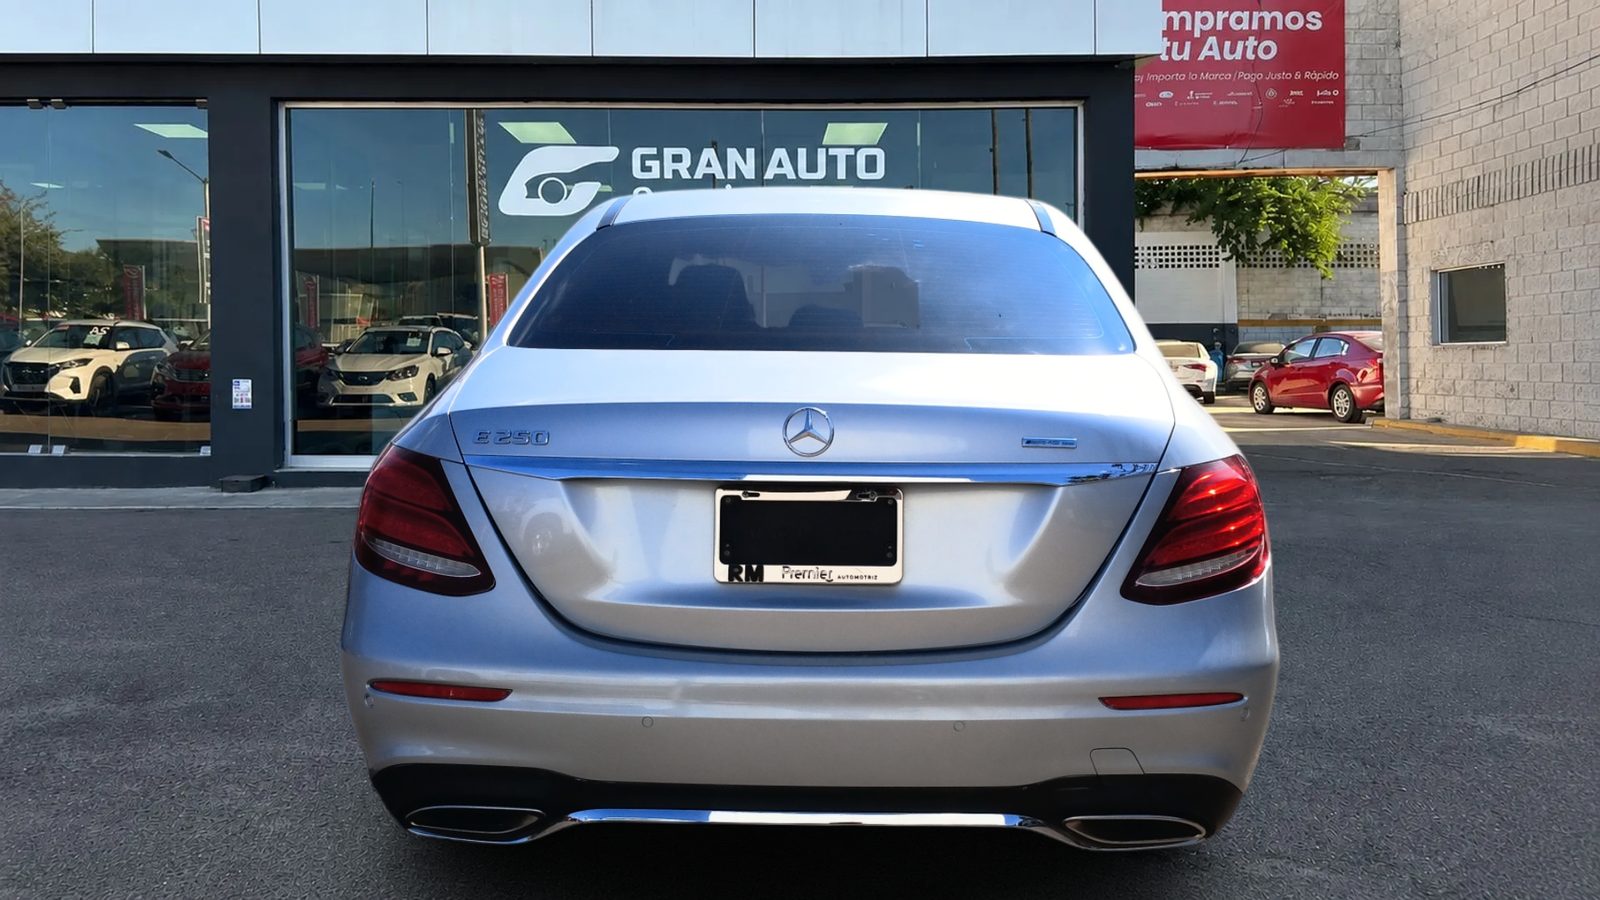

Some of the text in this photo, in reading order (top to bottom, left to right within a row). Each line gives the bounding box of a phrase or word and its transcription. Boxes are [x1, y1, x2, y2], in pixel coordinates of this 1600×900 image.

[1163, 10, 1323, 38] mpramos
[1161, 36, 1278, 61] tu Auto
[1146, 72, 1186, 83] Importa
[1188, 72, 1198, 81] la
[1200, 72, 1231, 81] Marca
[1265, 71, 1291, 81] Justo
[1294, 71, 1301, 80] &
[631, 147, 886, 180] GRAN AUTO
[493, 430, 550, 446] 250
[728, 564, 764, 582] RM
